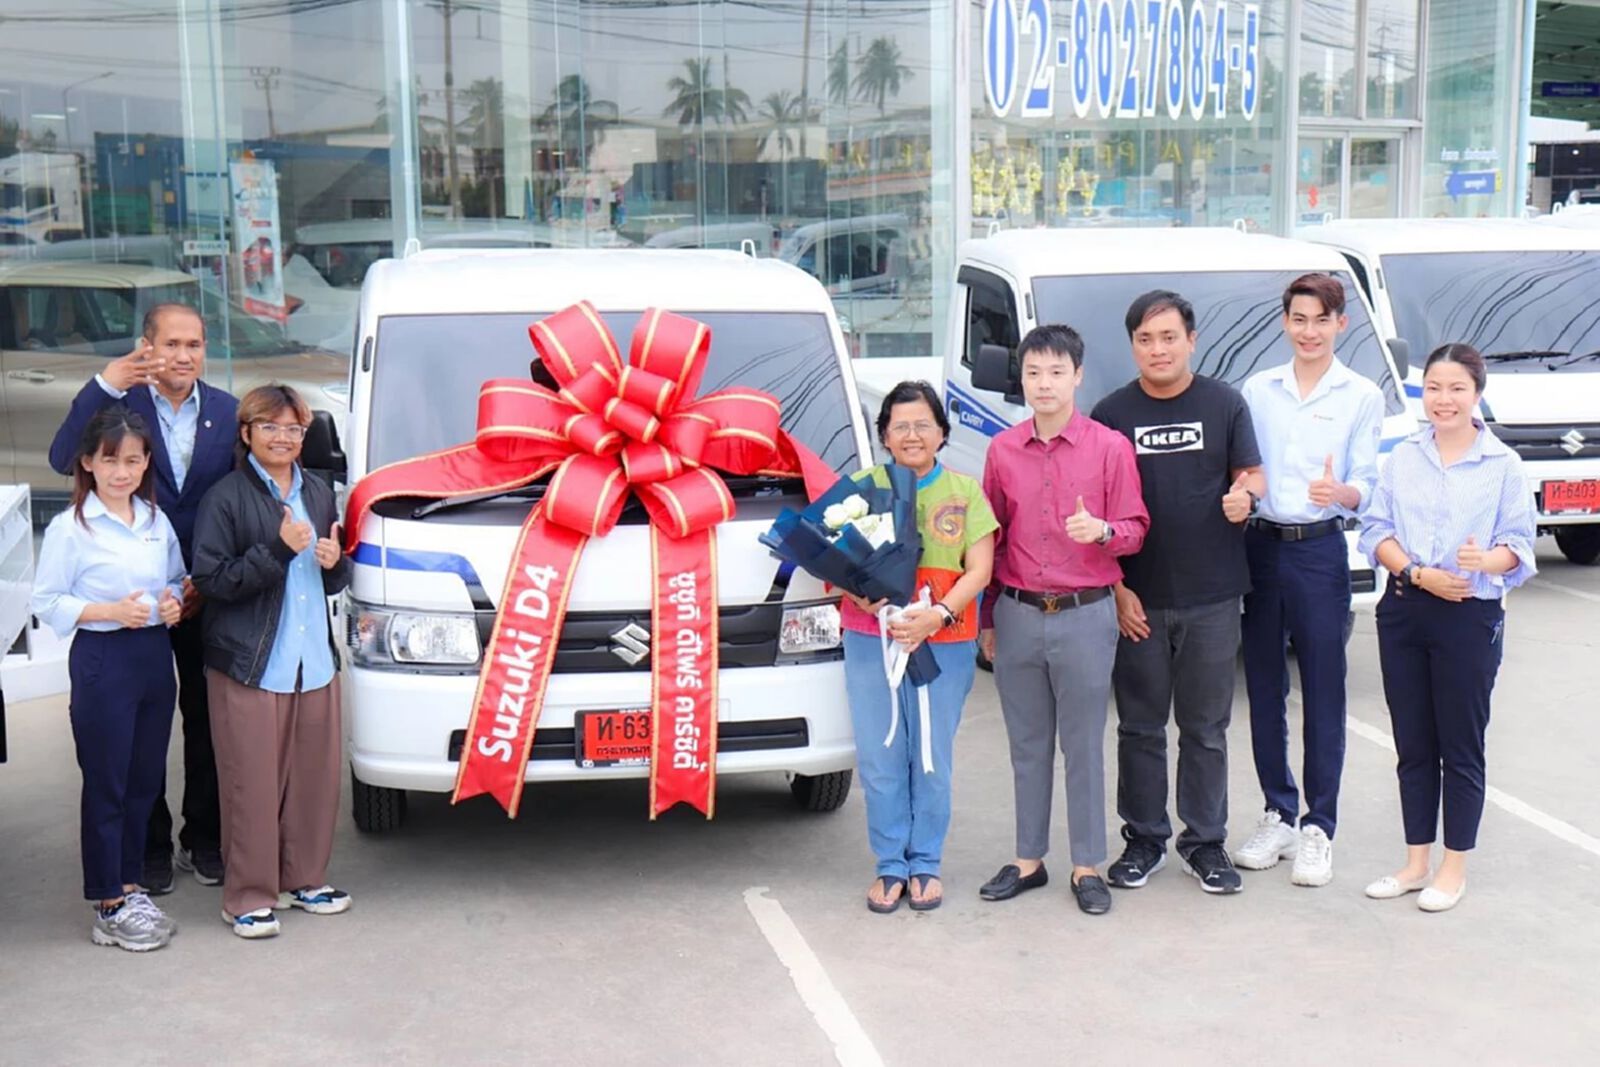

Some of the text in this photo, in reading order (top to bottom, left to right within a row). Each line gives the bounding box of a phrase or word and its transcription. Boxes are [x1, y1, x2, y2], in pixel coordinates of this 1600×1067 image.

[984, 0, 1259, 120] 02-8027884-5
[1142, 430, 1198, 446] IKEA
[478, 563, 559, 763] Suzuki D4
